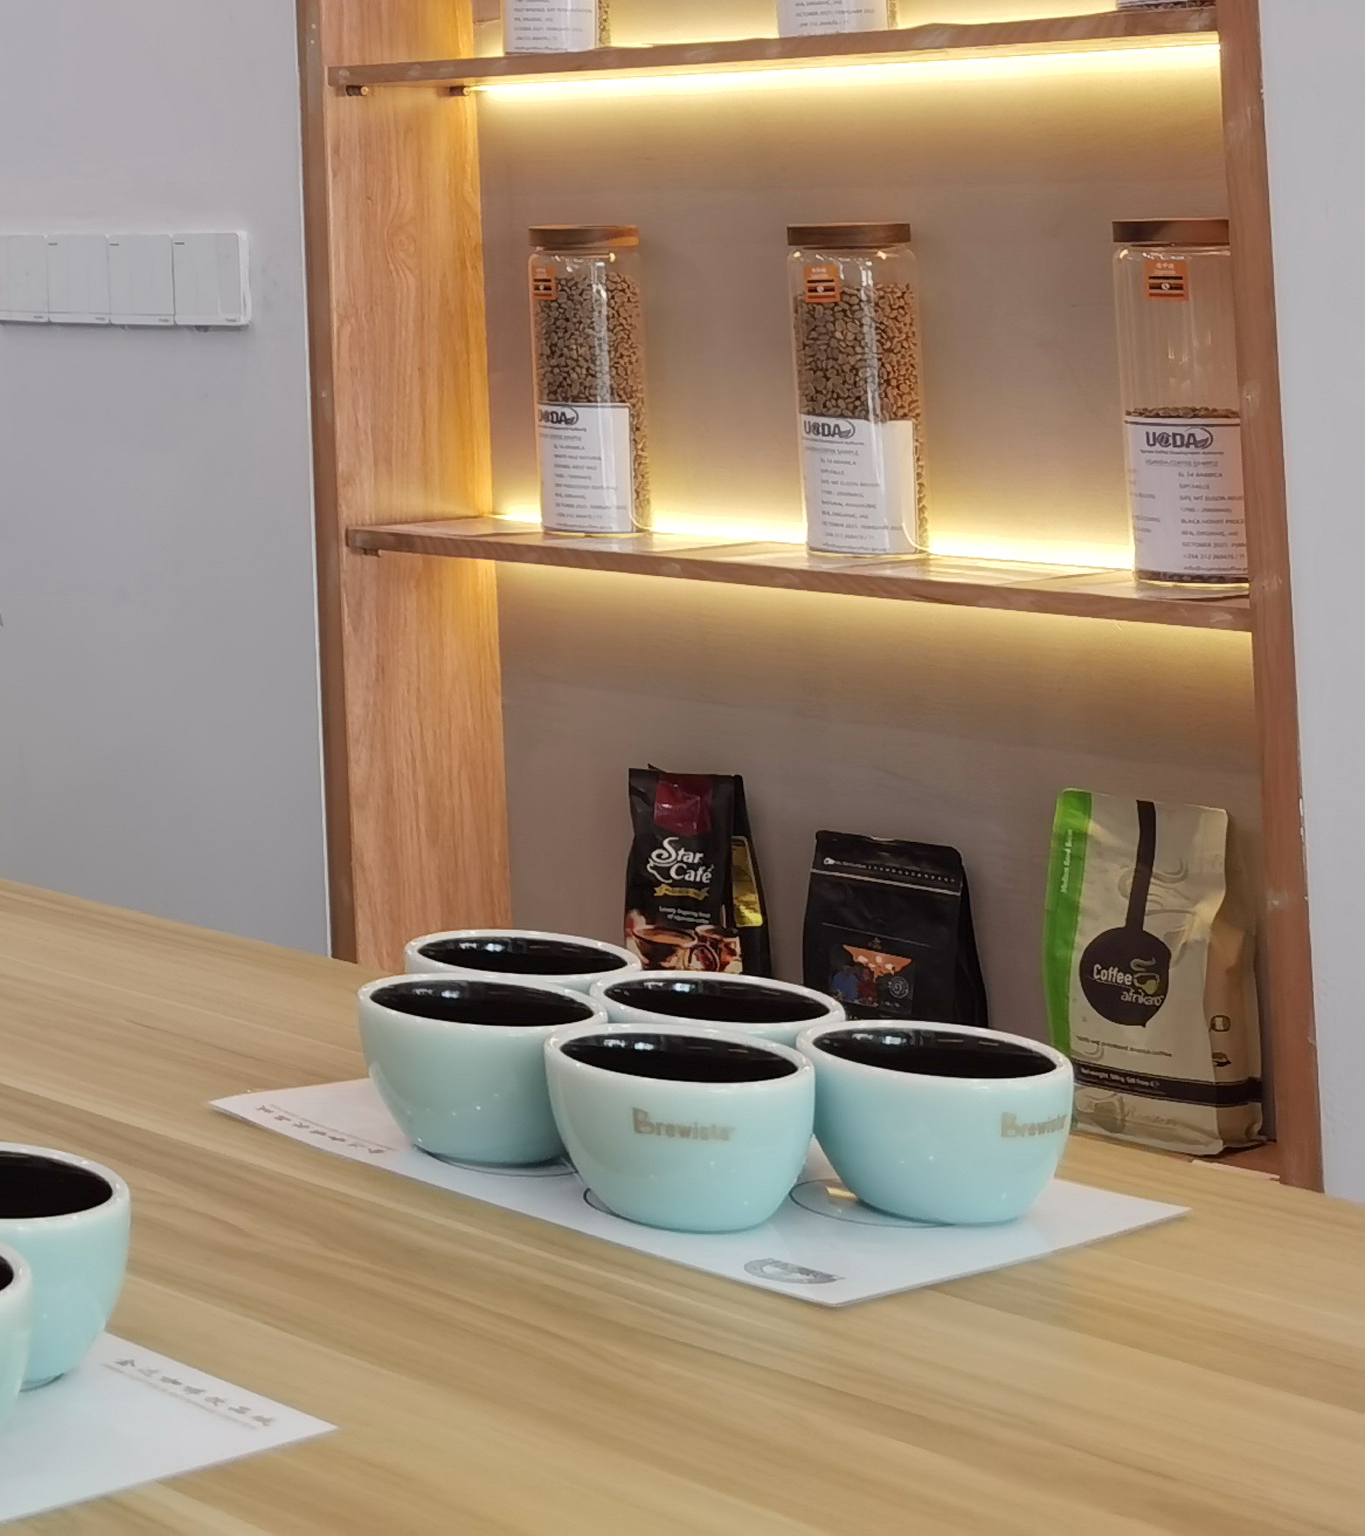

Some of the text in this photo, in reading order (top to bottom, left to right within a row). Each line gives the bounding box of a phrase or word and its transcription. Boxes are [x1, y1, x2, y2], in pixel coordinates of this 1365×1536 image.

[651, 837, 704, 864] Star
[670, 863, 715, 884] Café
[1093, 963, 1133, 986] Coffee
